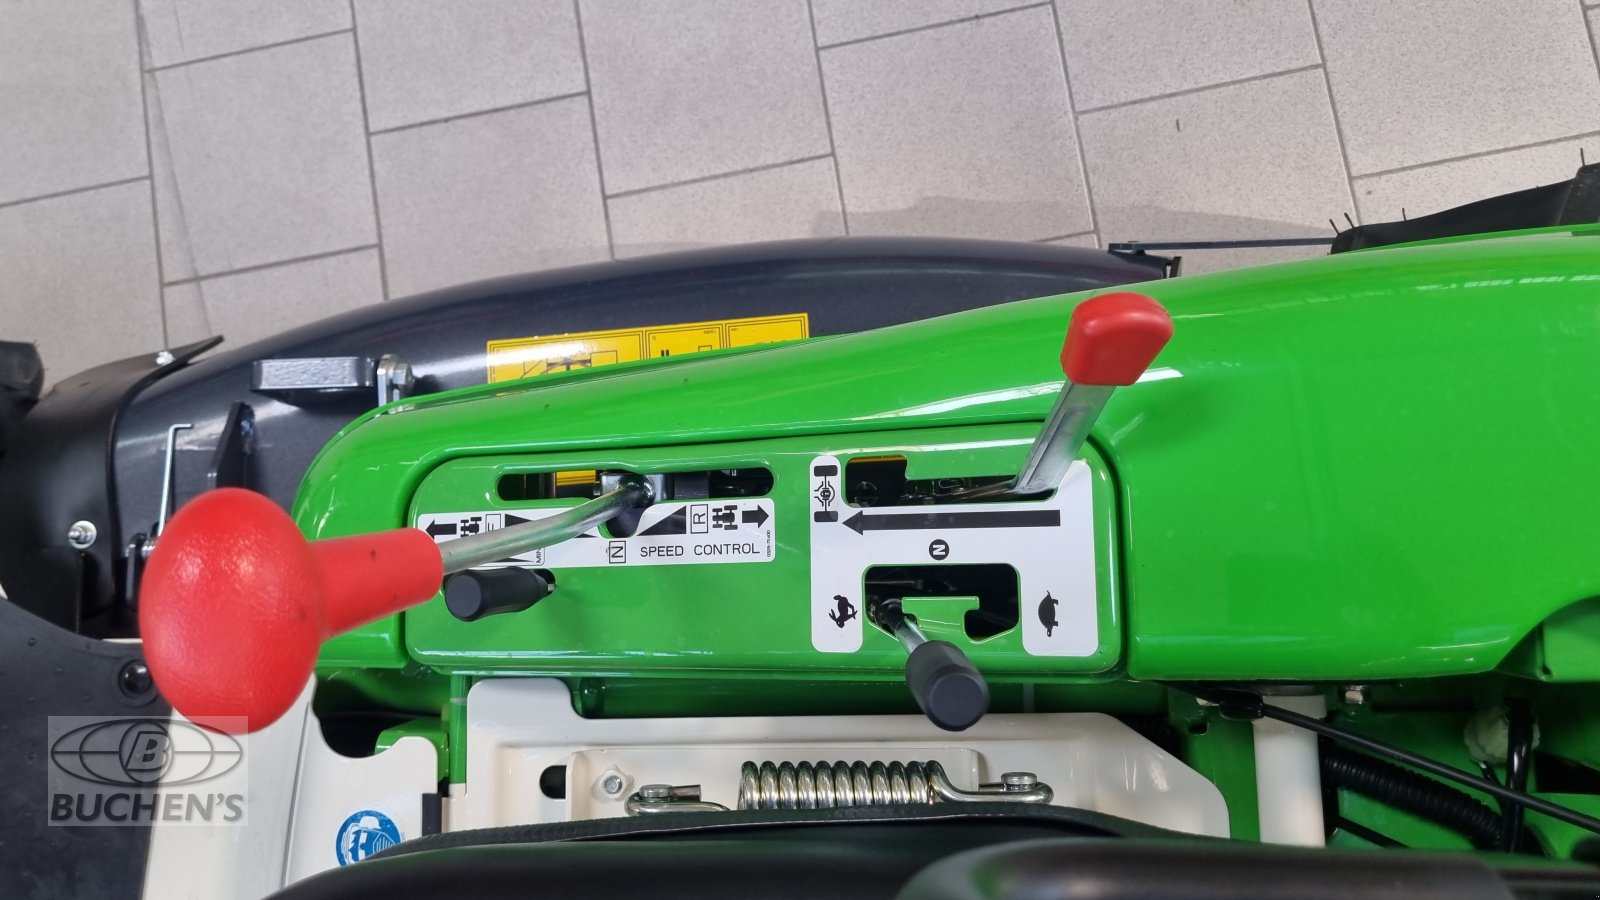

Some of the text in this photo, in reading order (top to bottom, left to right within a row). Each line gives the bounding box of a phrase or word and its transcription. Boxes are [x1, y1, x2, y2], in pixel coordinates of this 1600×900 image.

[694, 512, 706, 525] R
[611, 546, 624, 558] N
[640, 543, 760, 558] SPEED CONTROL
[932, 544, 946, 556] N
